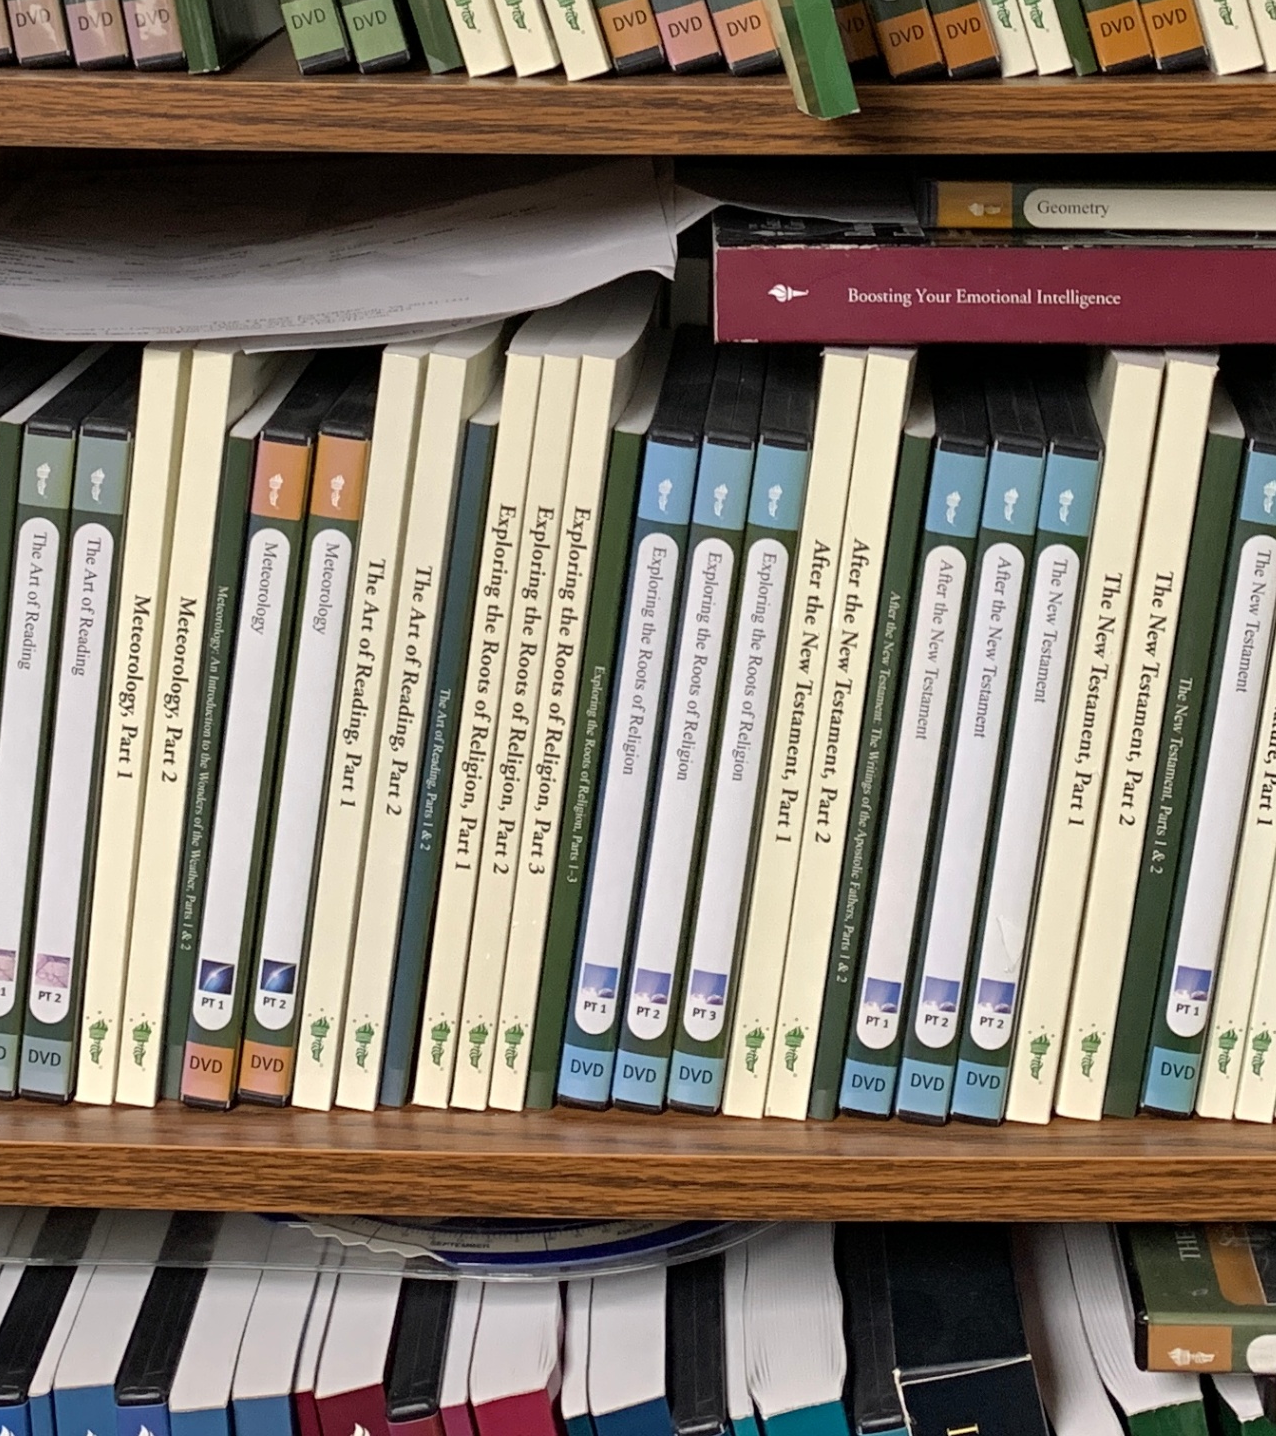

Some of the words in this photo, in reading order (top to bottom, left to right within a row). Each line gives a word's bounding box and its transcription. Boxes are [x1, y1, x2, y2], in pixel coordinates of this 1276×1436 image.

[1036, 197, 1111, 219] Geometry
[847, 286, 913, 309] Boosting
[914, 287, 953, 305] Your
[955, 287, 1033, 305] Emotional
[1036, 287, 1122, 311] Intelligence
[84, 536, 103, 566] The
[557, 505, 593, 602] Exploring
[81, 567, 99, 594] Art
[79, 596, 96, 617] of
[558, 606, 580, 638] the
[70, 616, 95, 677] Reading
[117, 593, 153, 719] Meteorology,
[550, 641, 575, 698] Roots
[547, 701, 567, 727] of
[117, 723, 140, 765] Part
[116, 770, 134, 780] 1
[533, 726, 565, 813] Religion,
[529, 817, 553, 859] Part
[527, 861, 547, 876] 3
[691, 1007, 707, 1020] PT
[708, 1010, 717, 1021] 3
[678, 1065, 714, 1085] DVD
